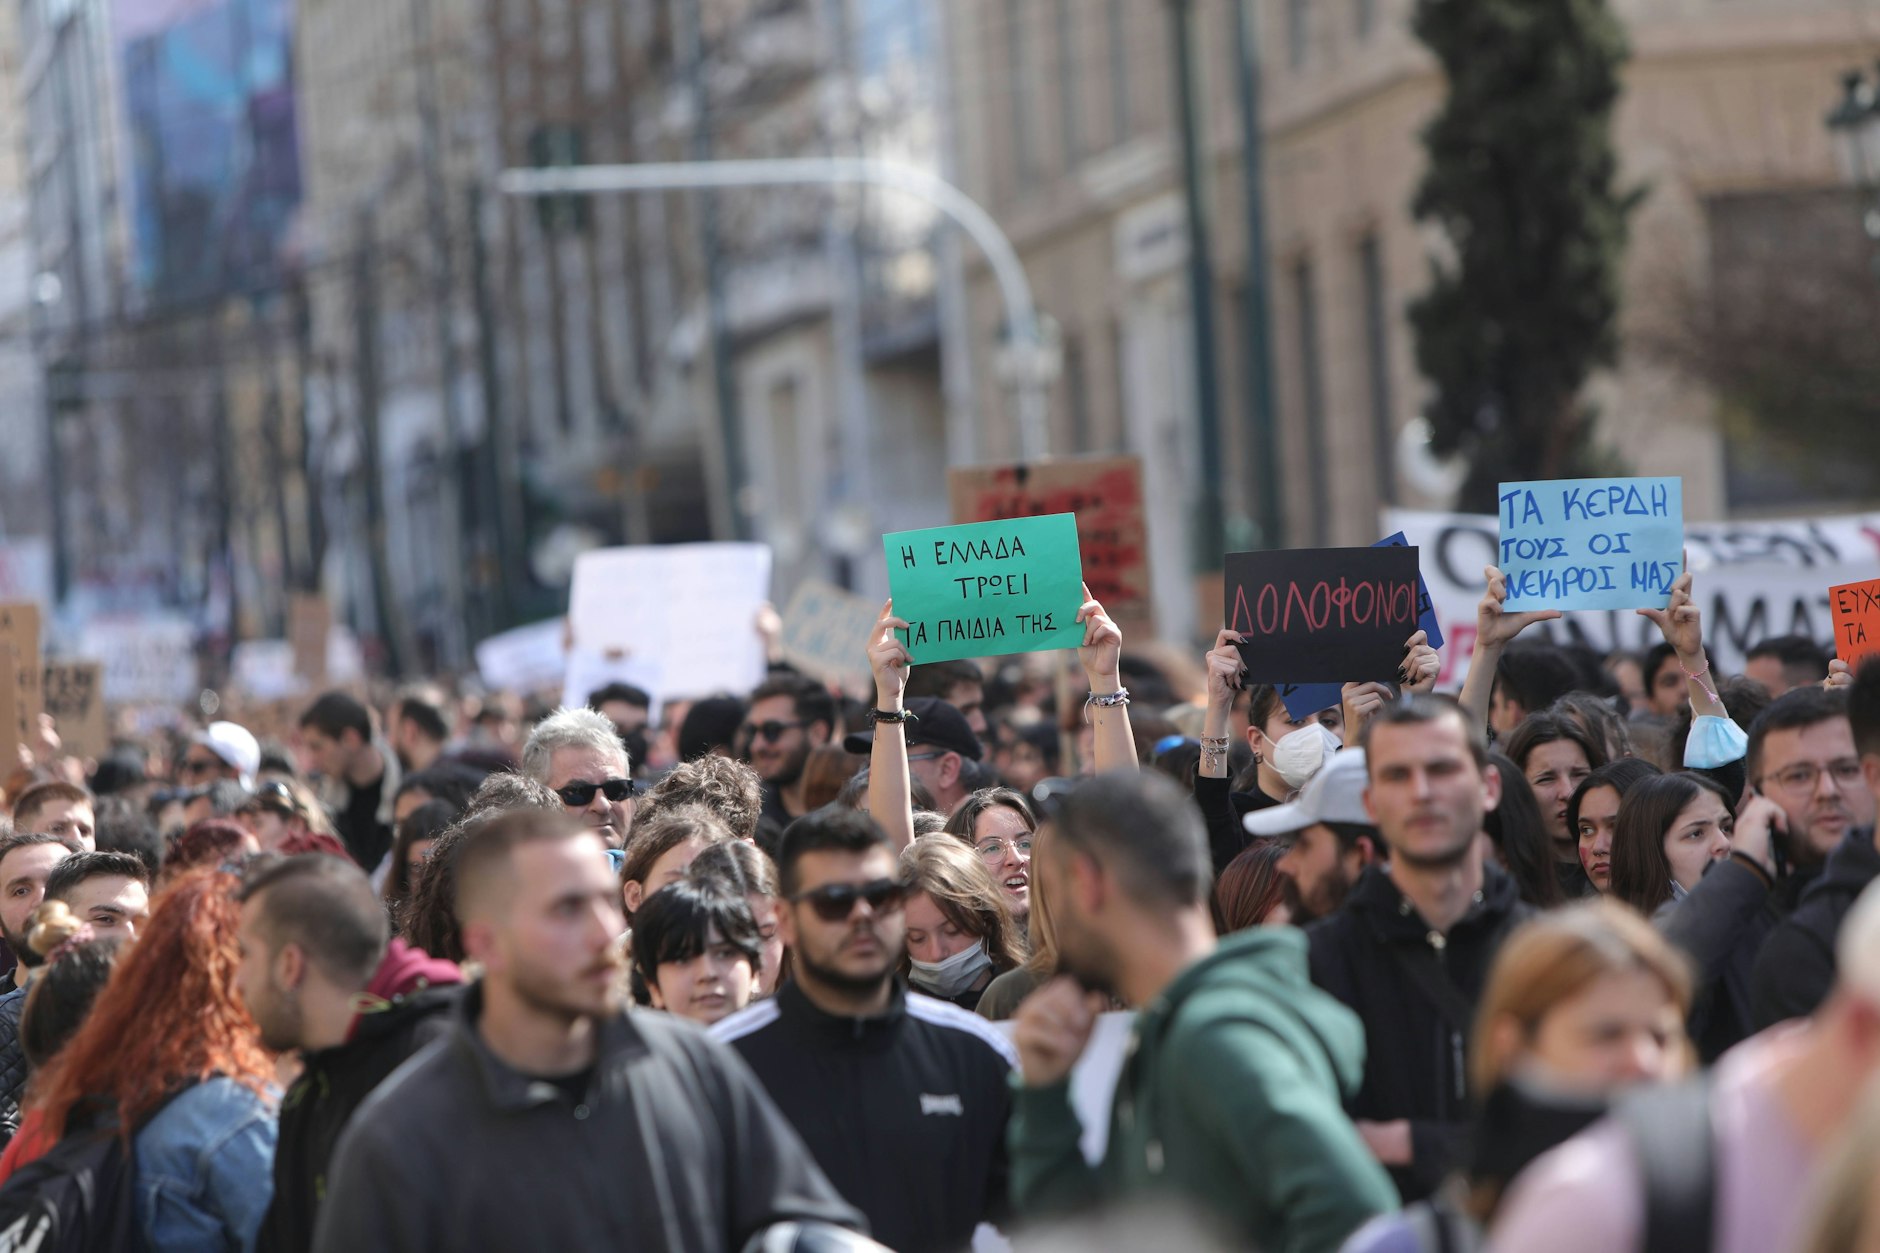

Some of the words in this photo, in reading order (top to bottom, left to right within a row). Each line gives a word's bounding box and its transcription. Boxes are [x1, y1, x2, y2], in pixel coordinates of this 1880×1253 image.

[1501, 490, 1544, 529] ΤΑ
[1562, 484, 1668, 521] ΚΕΡΔΗ
[901, 545, 916, 569] Η
[935, 536, 1026, 566] ΕΛΛΑΔΑ
[1501, 537, 1568, 564] ΤΟΥΣ
[1588, 532, 1632, 555] ΟΙ
[954, 573, 1028, 599] ΤΡΩΕΙ
[1505, 566, 1617, 601] ΝΕΚΡΟΙ
[1631, 561, 1679, 595] ΜΑΣ
[1231, 576, 1417, 637] ΔΟΛΟΦΟΝΟΙ
[905, 621, 927, 648] ΤΑ
[938, 617, 1005, 643] ΠΑΙΔΙΑ
[1016, 613, 1057, 635] ΤΗΣ
[1843, 622, 1867, 647] ΤΑ
